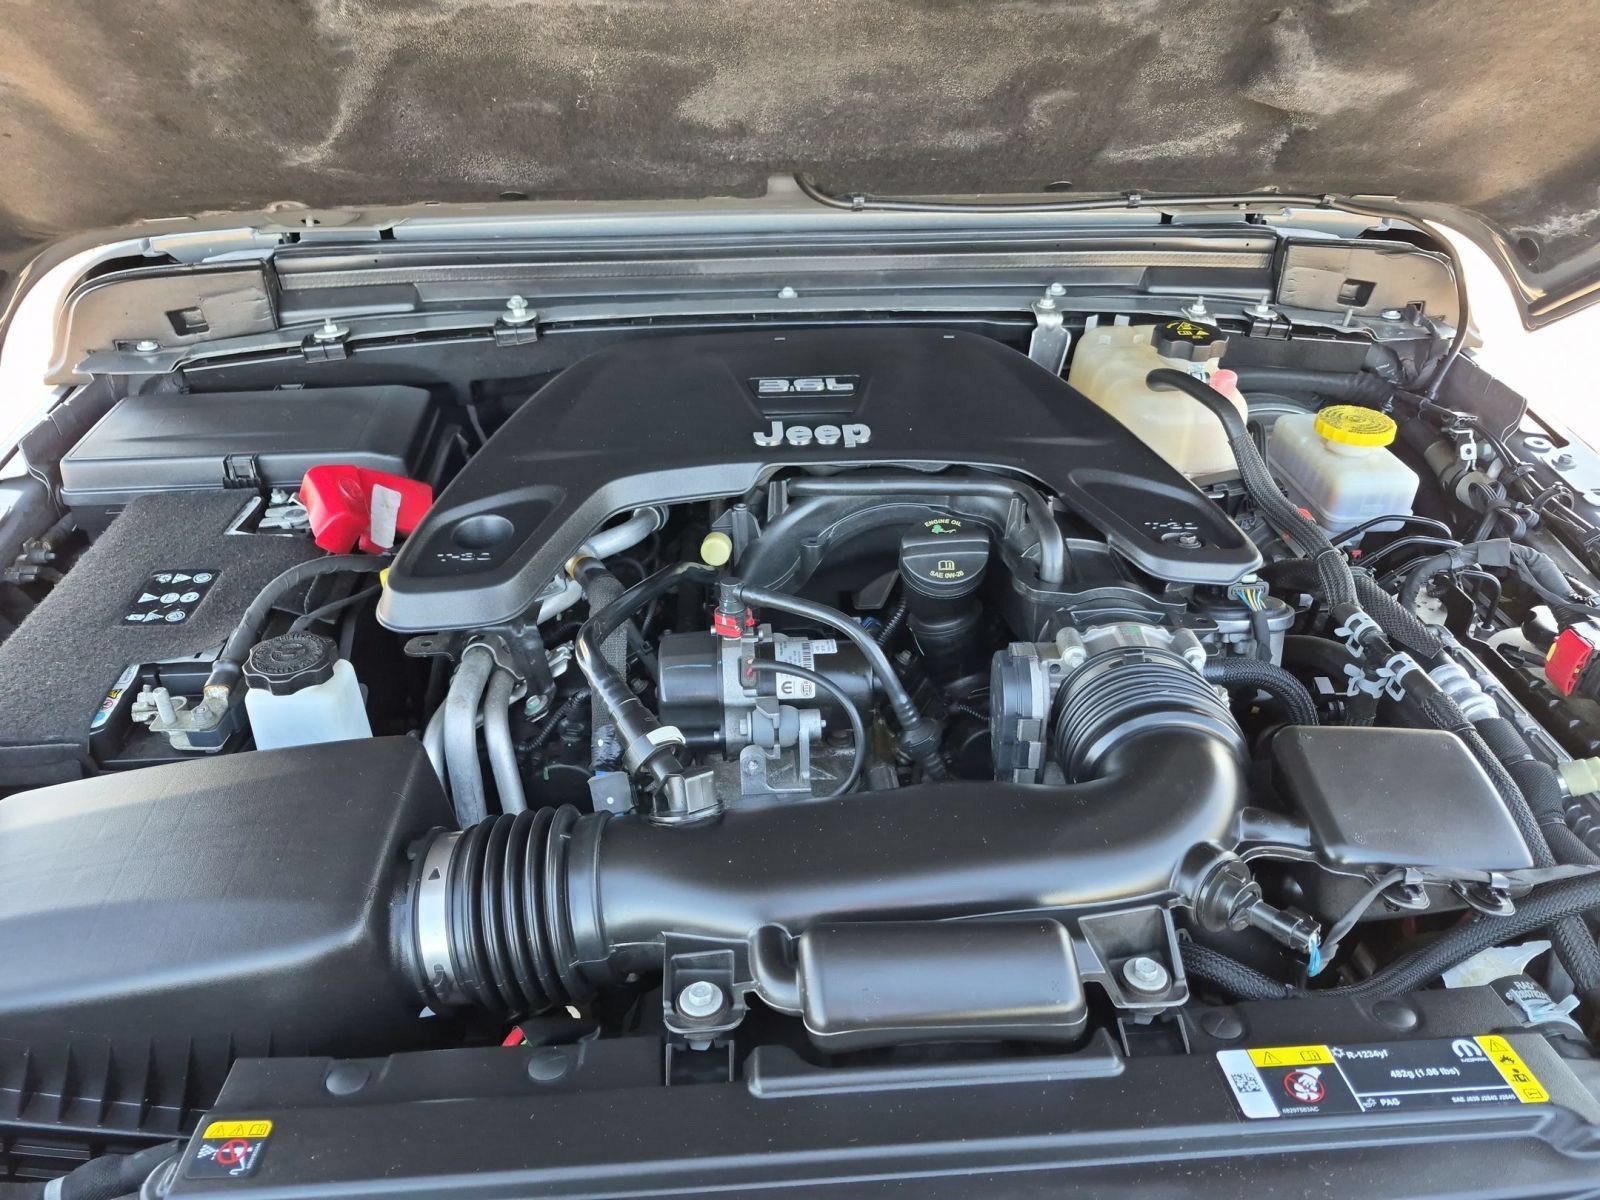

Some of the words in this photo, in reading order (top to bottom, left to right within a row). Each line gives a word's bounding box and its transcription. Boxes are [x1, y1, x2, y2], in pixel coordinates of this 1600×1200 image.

[758, 378, 854, 393] 3.6L
[753, 420, 872, 448] Jeep
[924, 519, 950, 527] ENGINE
[951, 519, 962, 527] OIL
[929, 570, 943, 578] SAE
[1346, 1049, 1388, 1059] R-1234yf
[1390, 1069, 1415, 1079] 482g
[1440, 1067, 1461, 1077] lbs)
[1380, 1097, 1401, 1107] PAG
